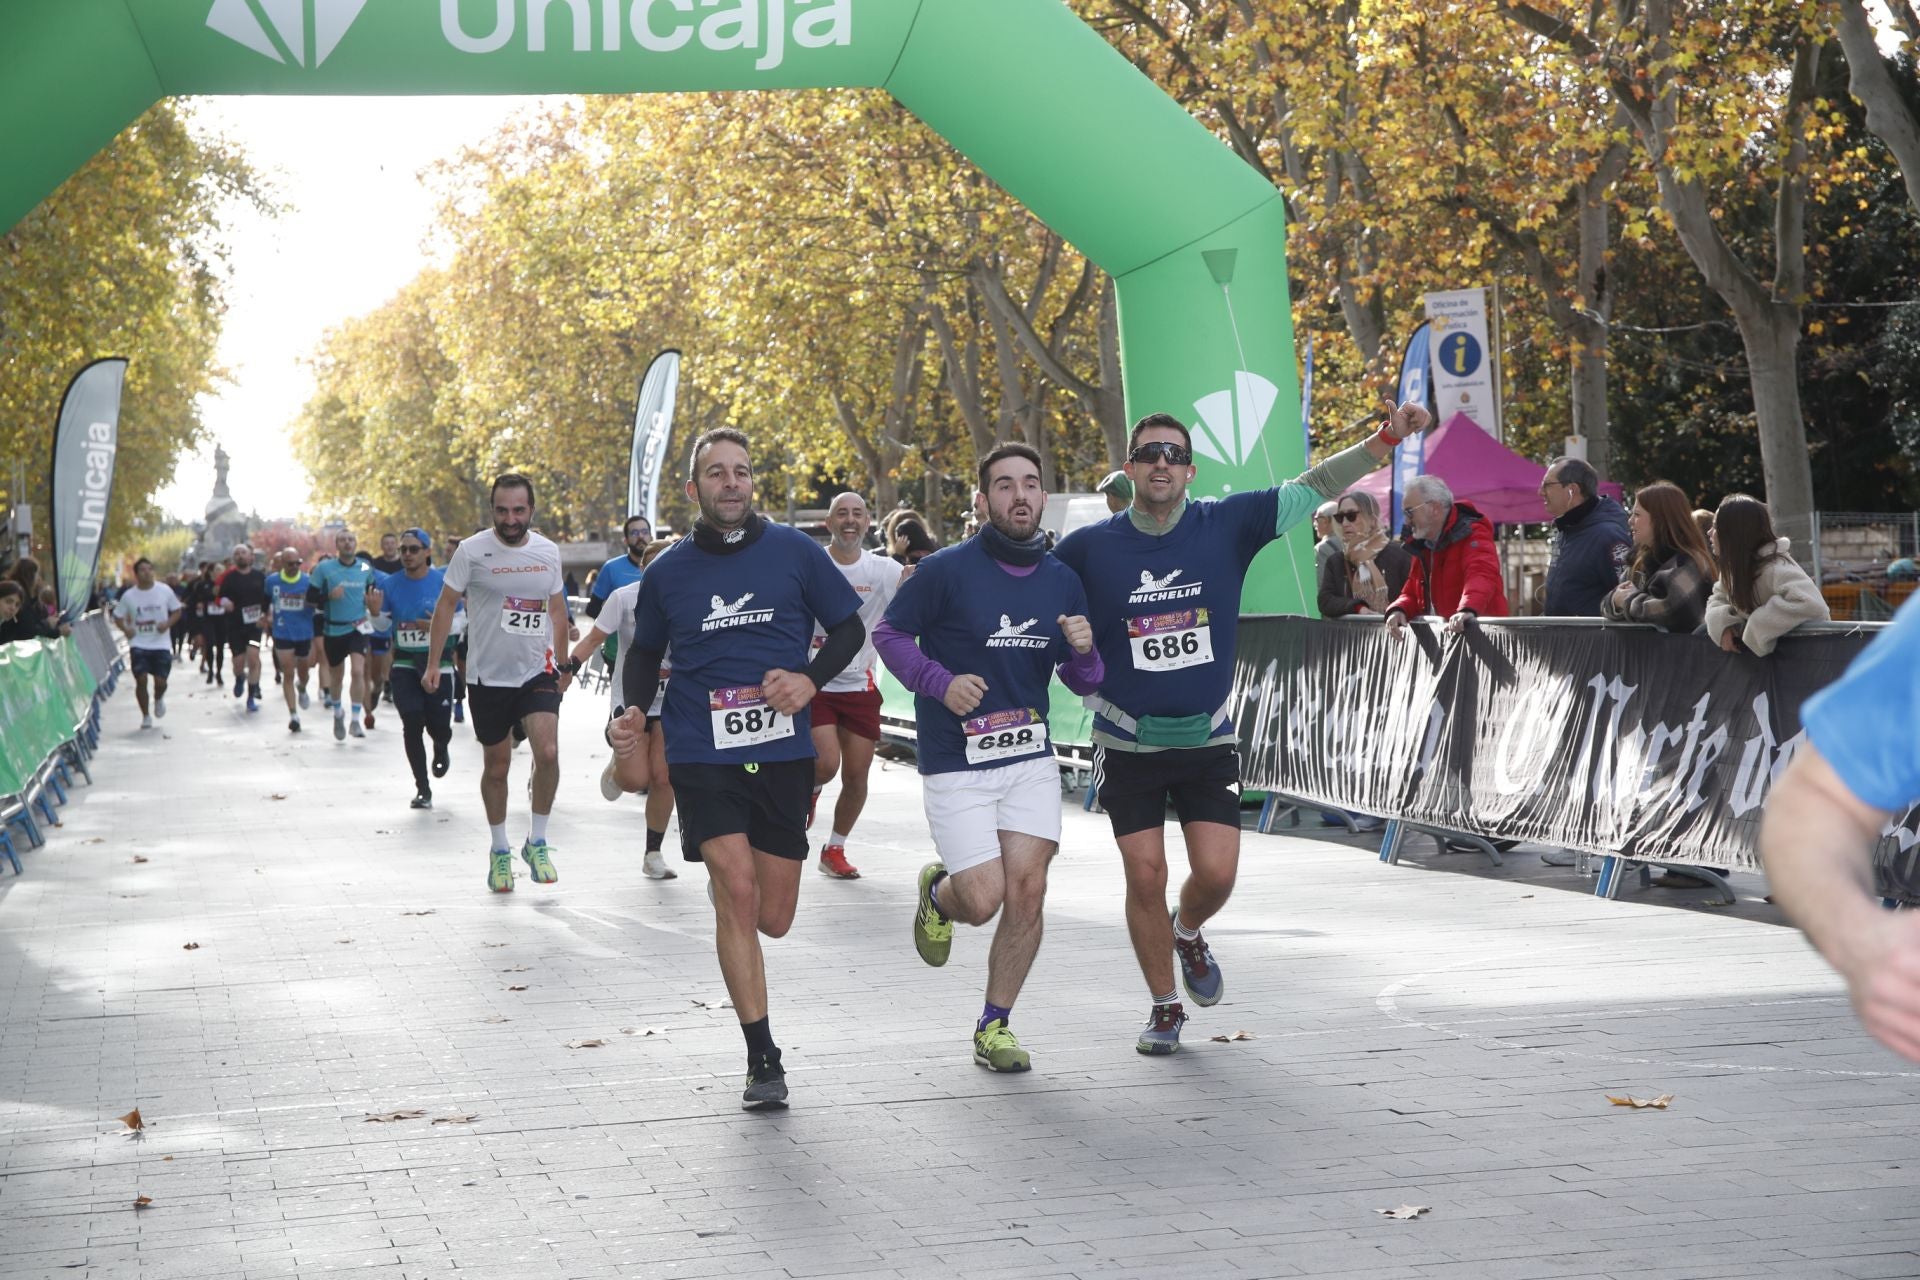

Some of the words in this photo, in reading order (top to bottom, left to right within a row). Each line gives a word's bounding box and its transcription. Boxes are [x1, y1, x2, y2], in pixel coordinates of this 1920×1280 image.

[440, 0, 852, 71] Unicaja
[76, 422, 116, 544] Unicaja
[492, 565, 548, 574] COLLOSA
[1128, 586, 1201, 604] MICHELIN
[508, 612, 541, 628] 215
[701, 612, 774, 632] MICHELIN
[402, 631, 427, 642] 112
[985, 638, 1049, 649] MICHELIN
[1142, 632, 1199, 661] 686
[724, 706, 778, 735] 687
[978, 728, 1033, 750] 688
